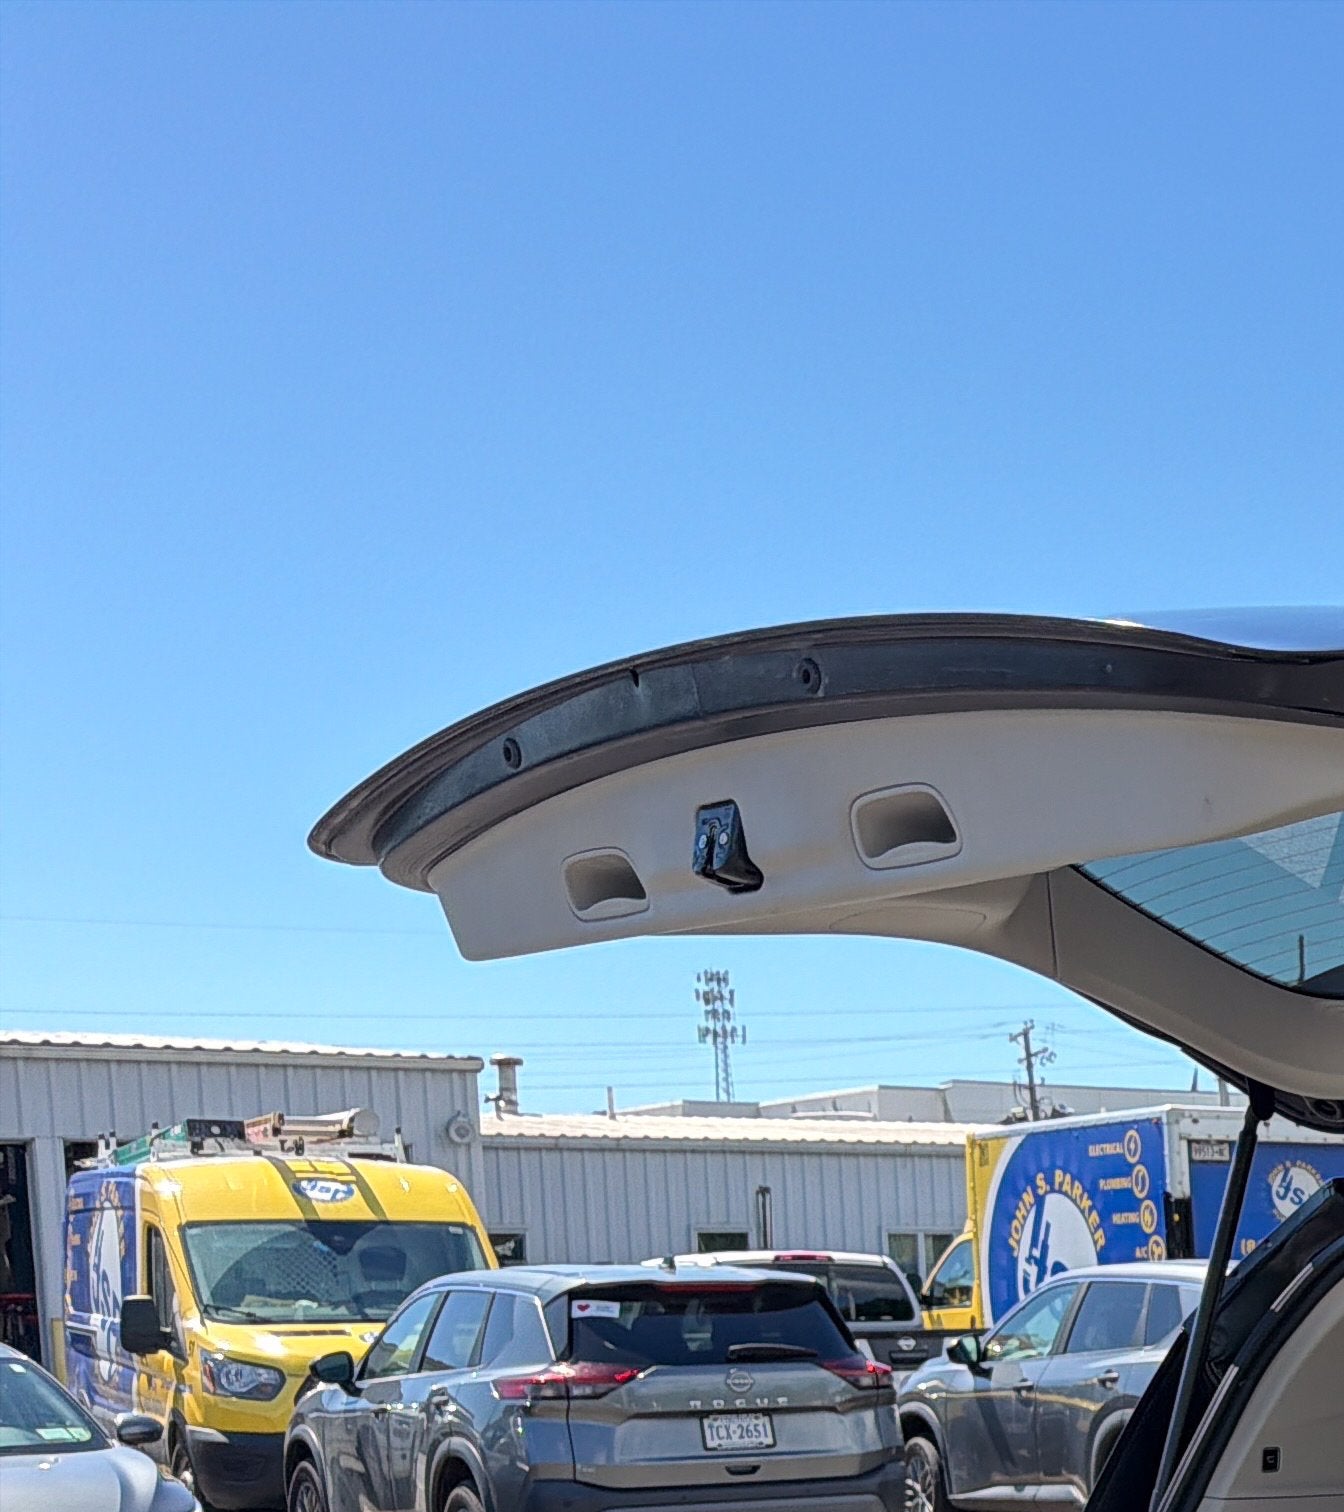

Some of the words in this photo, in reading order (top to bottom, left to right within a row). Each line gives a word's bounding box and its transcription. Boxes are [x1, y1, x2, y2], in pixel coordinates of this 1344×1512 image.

[1008, 1186, 1035, 1258] JOHN
[1036, 1172, 1050, 1196] S.
[1054, 1168, 1106, 1252] PARKER
